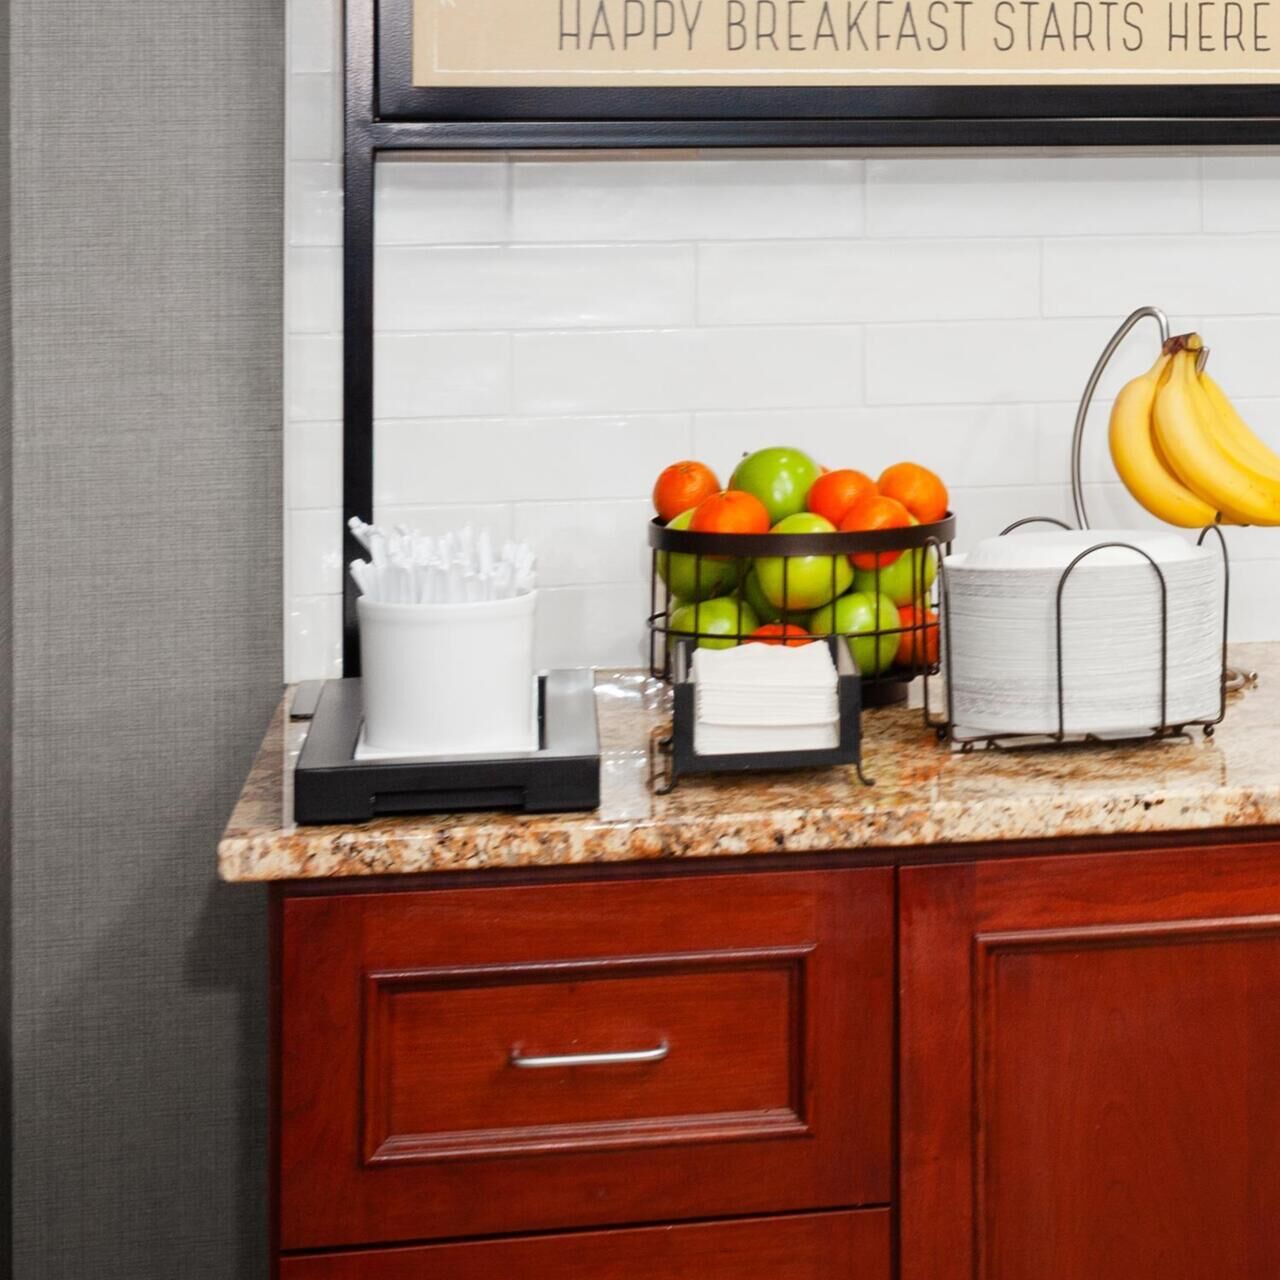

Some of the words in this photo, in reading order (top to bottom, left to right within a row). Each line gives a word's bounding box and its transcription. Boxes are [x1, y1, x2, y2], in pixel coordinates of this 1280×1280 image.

[727, 0, 973, 52] BREAKFAST
[993, 1, 1144, 52] STARTS
[1168, 1, 1272, 52] HERE
